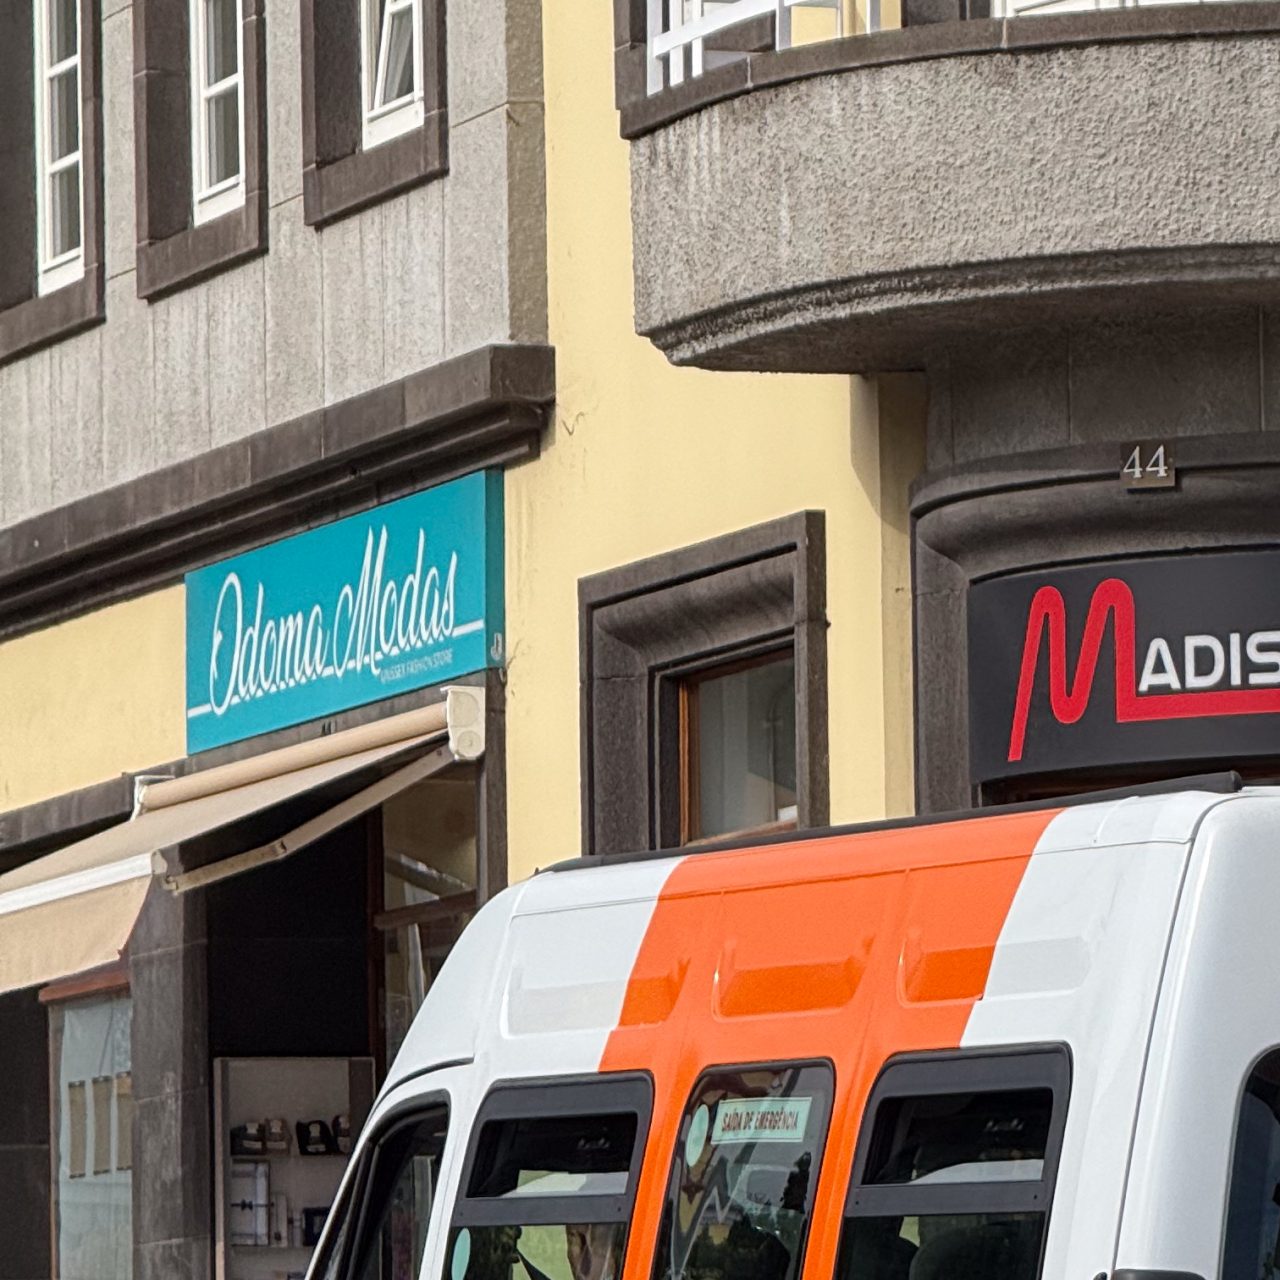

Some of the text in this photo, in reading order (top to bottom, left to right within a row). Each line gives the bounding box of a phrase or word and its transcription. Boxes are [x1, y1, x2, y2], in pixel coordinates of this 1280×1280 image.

[1123, 445, 1168, 478] 44
[210, 524, 458, 715] Odoma Modas
